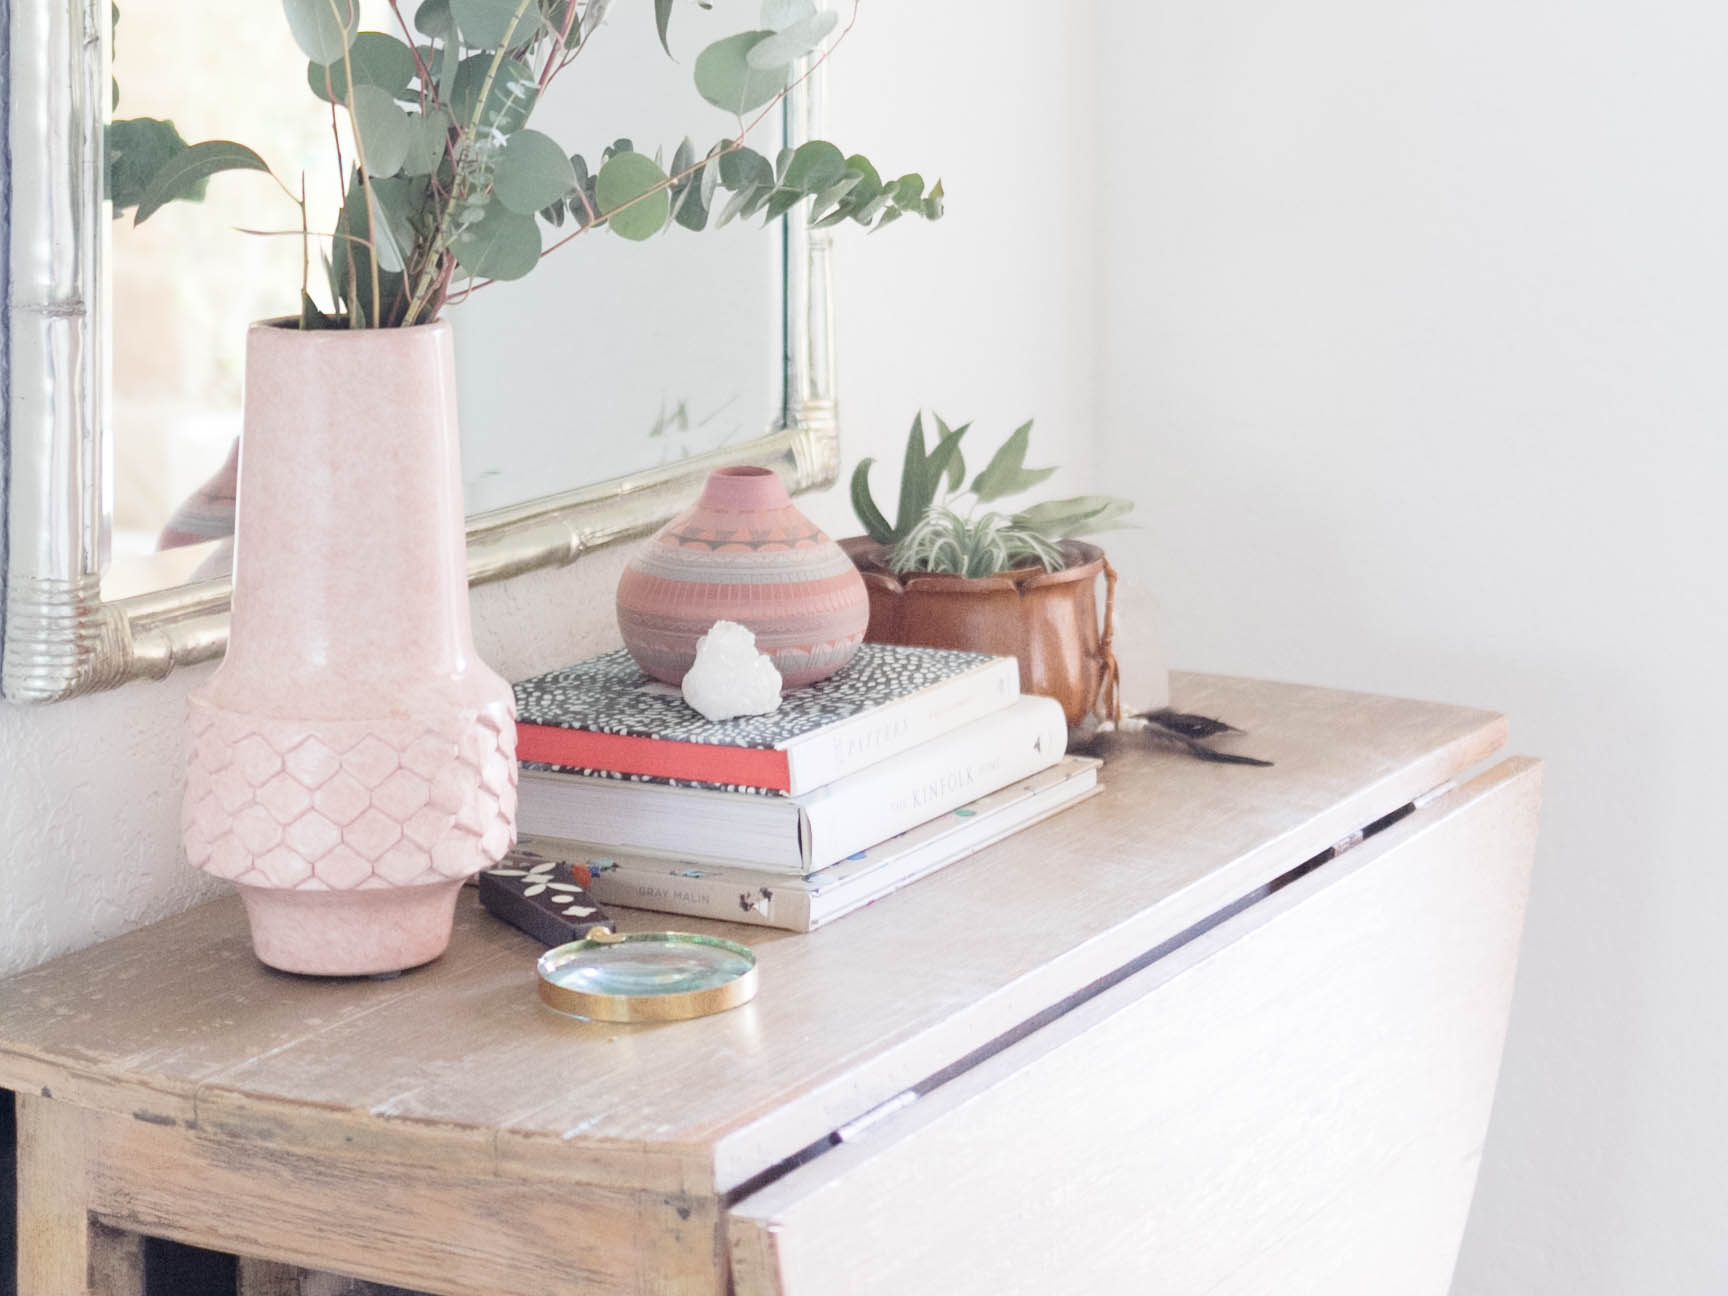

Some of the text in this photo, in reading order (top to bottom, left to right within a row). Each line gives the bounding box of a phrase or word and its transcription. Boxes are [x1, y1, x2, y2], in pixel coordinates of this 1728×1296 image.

[911, 767, 976, 809] KINFOLK
[637, 885, 711, 905] GRAY MALIN
